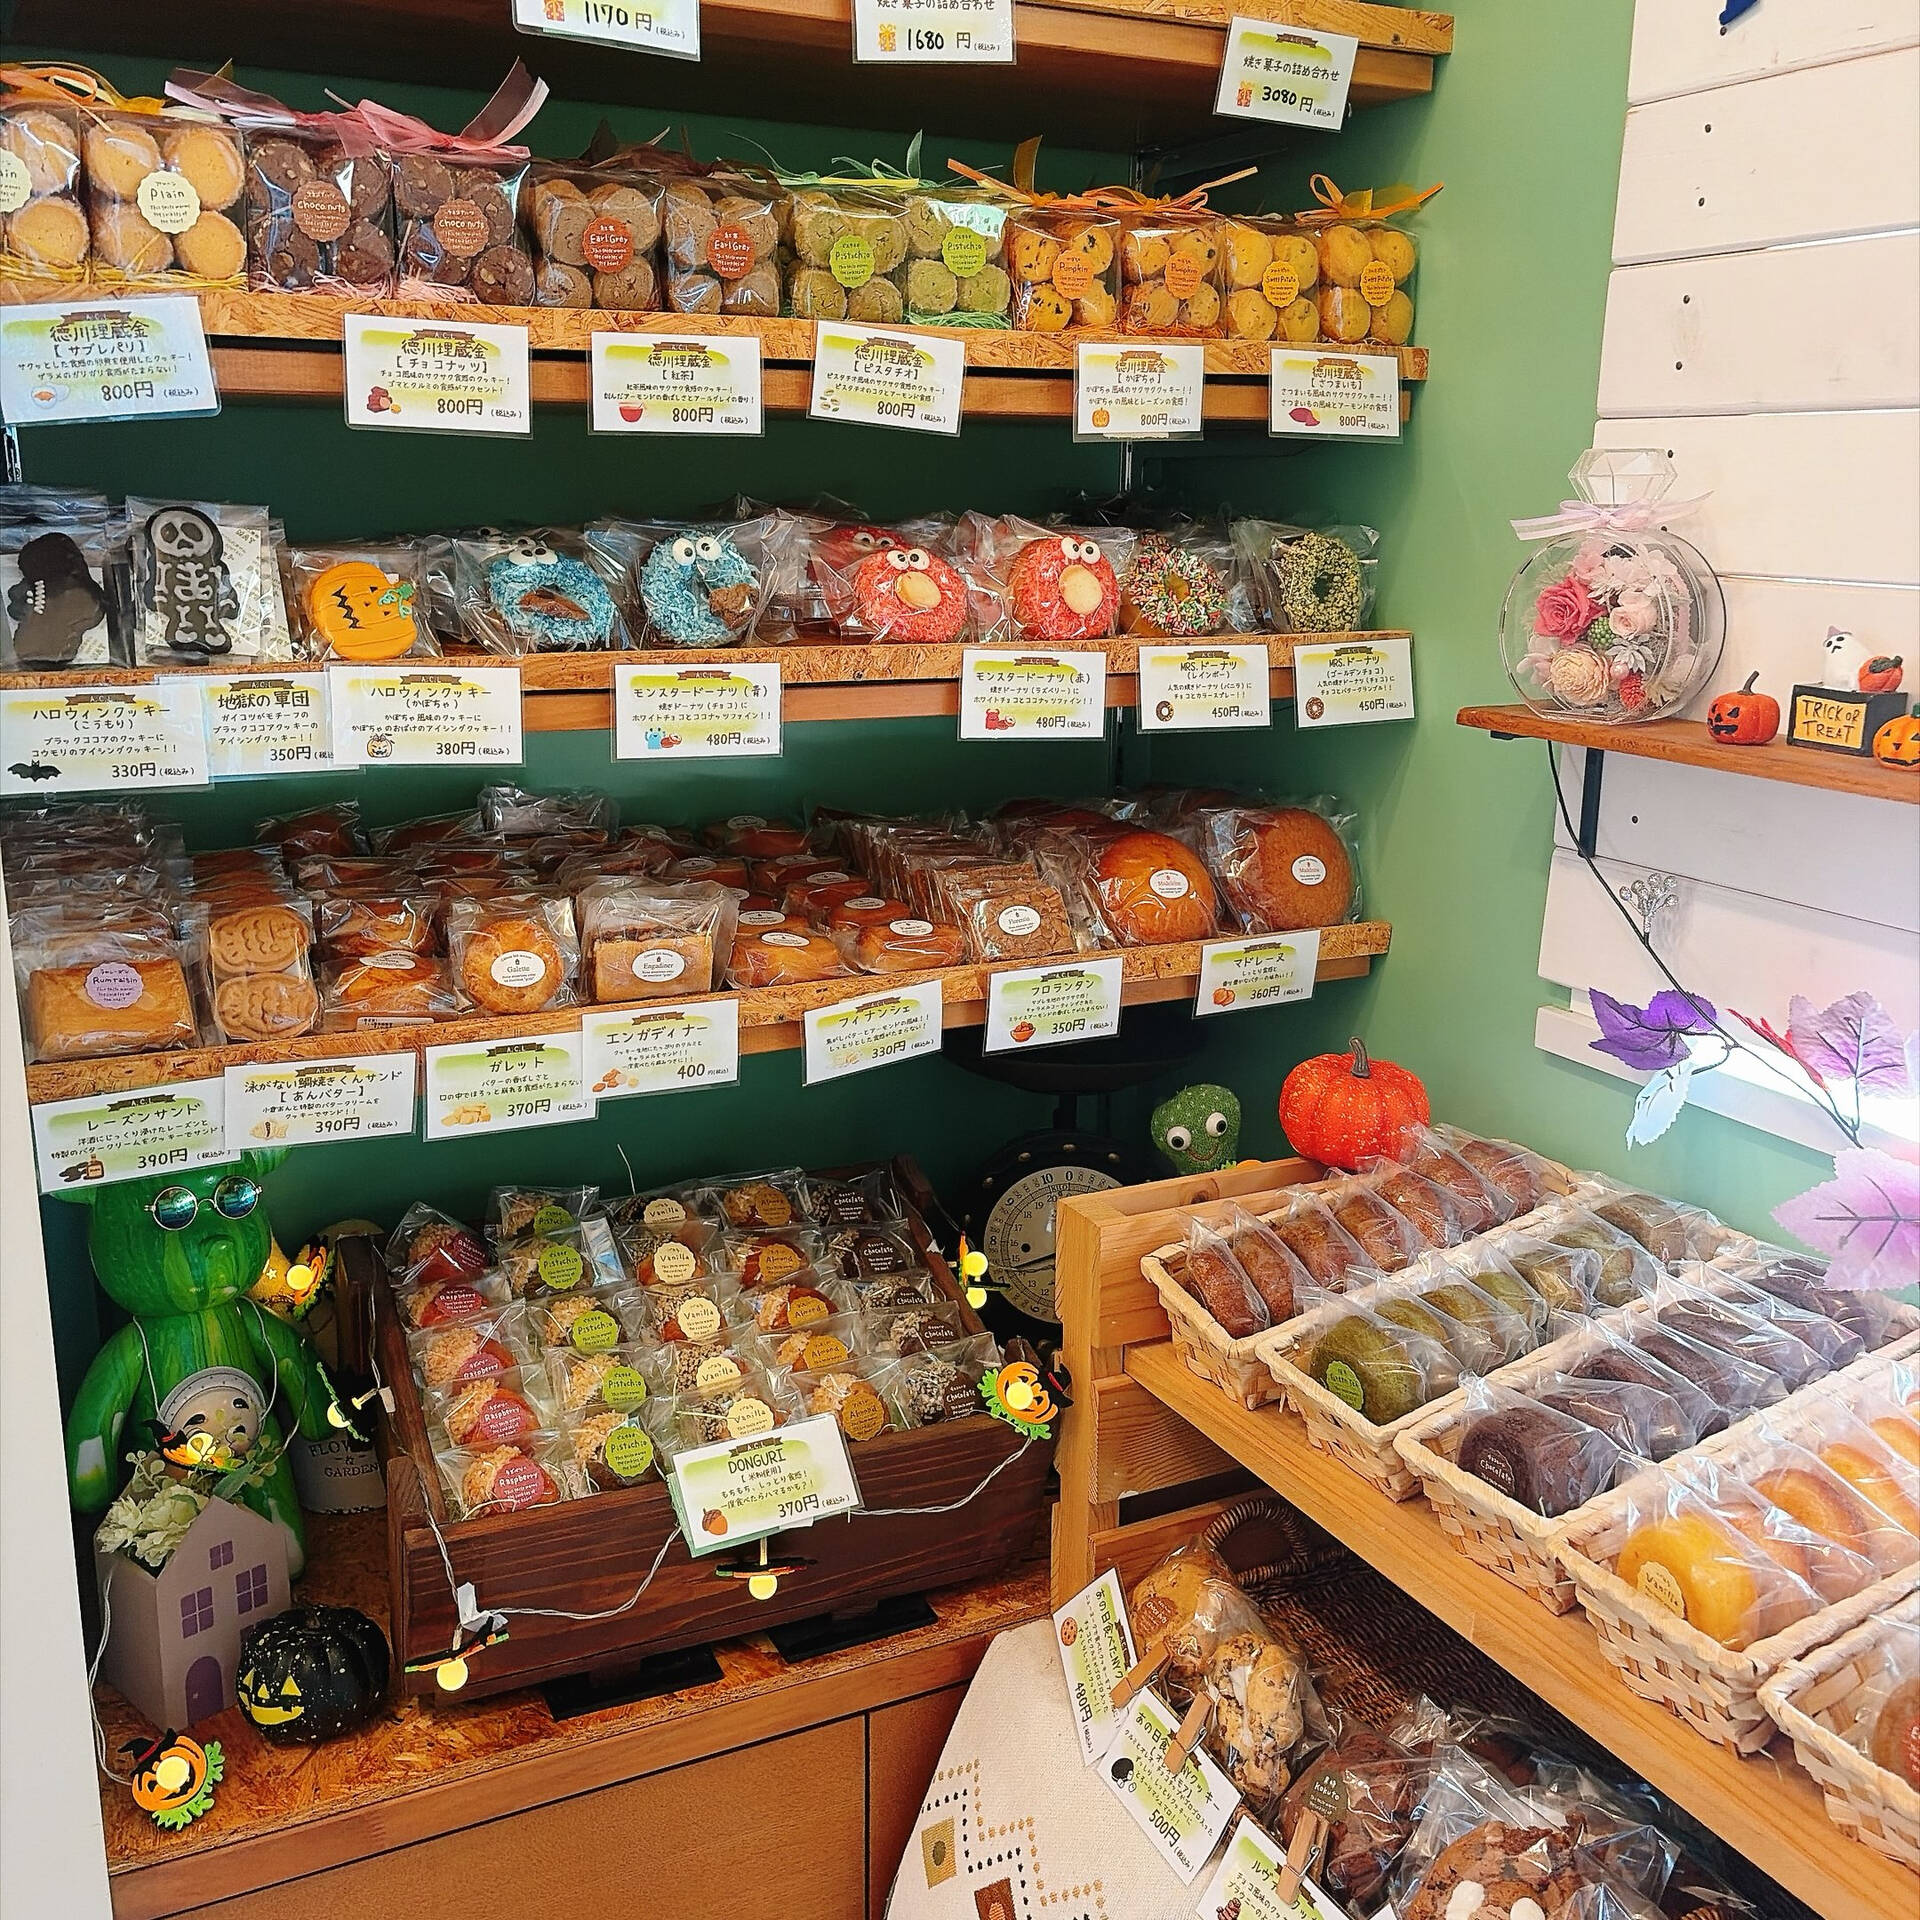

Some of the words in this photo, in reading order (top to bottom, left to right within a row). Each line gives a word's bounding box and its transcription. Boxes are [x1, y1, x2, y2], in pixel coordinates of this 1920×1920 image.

[585, 1, 652, 31] 1170円
[908, 29, 971, 50] 1680円
[1243, 55, 1339, 82] 焼き菓子の詰め合わせ
[1262, 86, 1313, 112] 3080円
[150, 188, 185, 201] Plain
[948, 242, 982, 250] Pistachio
[50, 321, 150, 342] 徳川埋蔵金
[401, 339, 488, 359] 徳川埋蔵金
[855, 345, 925, 368] 徳川埋蔵金
[648, 354, 713, 368] 徳川埋蔵金
[1115, 361, 1168, 373] 徳川埋蔵金
[662, 370, 695, 381] 【紅茶】
[854, 361, 918, 380] 【ピスタチオ】
[1118, 373, 1161, 383] 【かぼちゃ】
[1312, 366, 1364, 380] 徳川埋蔵金
[101, 381, 153, 401] 800円
[1311, 379, 1362, 390] 【さつまいも】
[437, 399, 483, 415] 800円
[877, 401, 915, 419] 800円
[672, 408, 713, 423] 800円
[1140, 413, 1168, 426] 800円
[1339, 416, 1367, 428] 800円
[218, 690, 310, 710] 地獄の軍団
[371, 686, 492, 698] ハロウィンクッキー
[33, 704, 171, 720] ハロウィンクッキー
[1212, 706, 1239, 718] 450円
[1359, 698, 1384, 712] 450円
[1802, 699, 1842, 722] TRICK
[221, 711, 309, 722] ガイコツがモチーフの
[1036, 716, 1065, 729] 480円
[213, 723, 318, 734] ブラックココアクッキーの
[1802, 720, 1855, 744] TREAT
[706, 732, 741, 746] 480円
[270, 746, 311, 761] 350円
[436, 741, 476, 755] 380円
[111, 762, 156, 778] 330円
[1233, 952, 1285, 968] マドレーヌ
[1032, 980, 1094, 996] フロランタン
[1250, 985, 1280, 1000] 360円
[839, 1005, 911, 1028] フィナンシェ
[606, 1024, 708, 1045] エンガディナー
[1051, 1018, 1086, 1035] 350円
[871, 1040, 906, 1059] 330円
[490, 1056, 544, 1073] ガレット
[677, 1063, 705, 1080] 400
[245, 1070, 403, 1094] 泳がない鯛焼きくんサンド
[280, 1086, 365, 1103] 【あんバター】
[507, 1099, 550, 1117] 370円
[88, 1102, 201, 1131] レーズンサンド
[315, 1116, 360, 1133] 390円
[137, 1148, 188, 1169] 390円
[1041, 1173, 1053, 1184] 10
[1066, 1171, 1073, 1180] 0
[990, 1235, 997, 1246] 8
[1011, 1239, 1019, 1247] 16
[1041, 1288, 1049, 1296] 12
[683, 1310, 714, 1320] Vanilla
[701, 1368, 734, 1382] Vanilla
[484, 1407, 520, 1422] Raspberry
[610, 1439, 647, 1453] Pistachio
[728, 1447, 787, 1474] DONGURI
[324, 1464, 380, 1478] GARDEN
[499, 1472, 538, 1487] Raspberry
[777, 1493, 819, 1518] 370円
[1075, 1682, 1093, 1723] 480円
[1149, 1809, 1181, 1847] 500円
